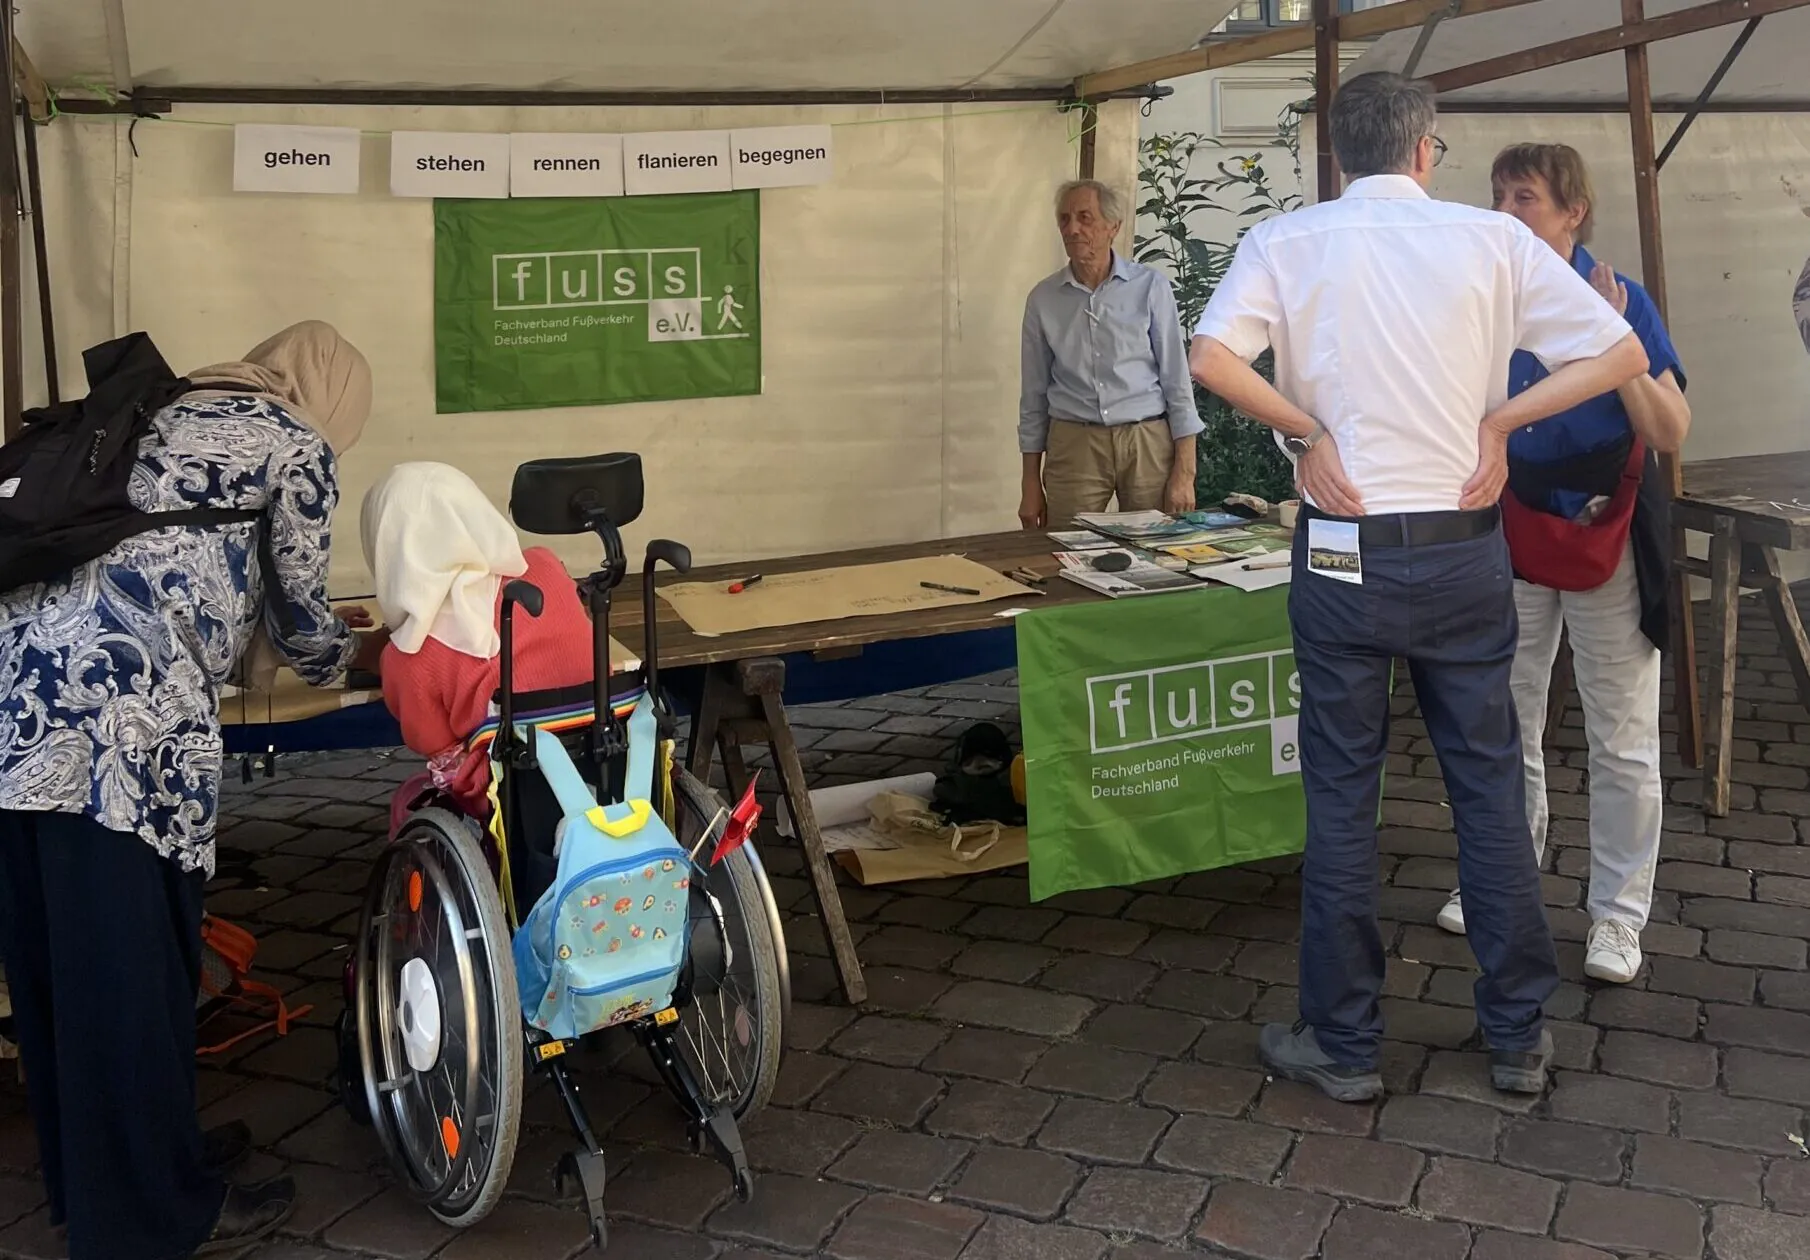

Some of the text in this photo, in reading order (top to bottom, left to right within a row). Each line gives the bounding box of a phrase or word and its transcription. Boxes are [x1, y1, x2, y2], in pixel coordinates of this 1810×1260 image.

[264, 148, 331, 169] gehen
[416, 154, 485, 172] stehen
[533, 158, 600, 171] rennen
[637, 152, 718, 169] flanieren
[738, 146, 826, 165] begegnen
[511, 261, 686, 301] fuss
[494, 314, 635, 331] Fachverband Fußverkehr
[656, 312, 695, 333] e.V.
[494, 332, 568, 346] Deutschland
[1091, 753, 1180, 780] Fachverband
[1183, 742, 1256, 765] Fußverkehr
[1091, 775, 1180, 799] Deutschland
